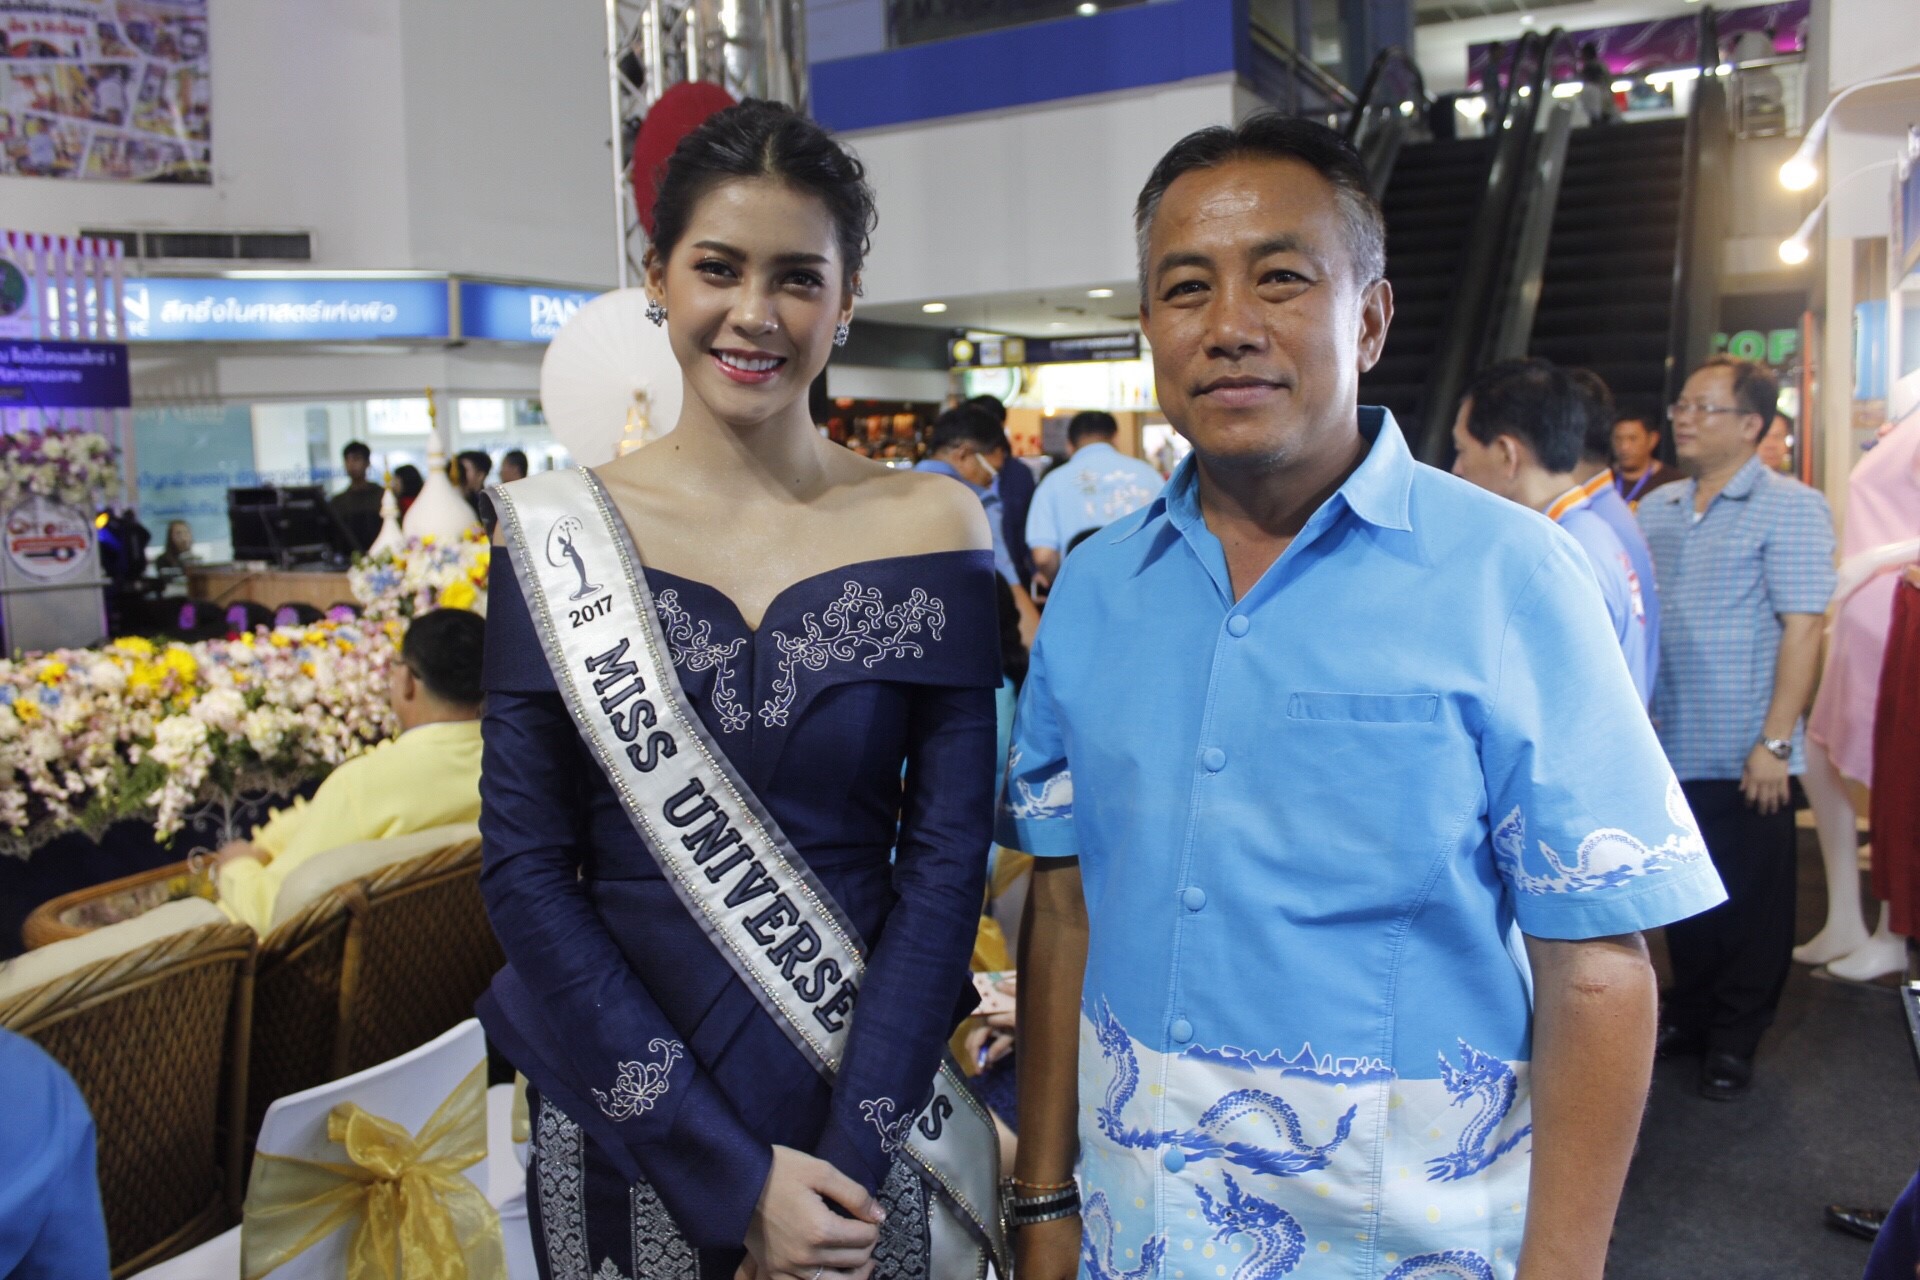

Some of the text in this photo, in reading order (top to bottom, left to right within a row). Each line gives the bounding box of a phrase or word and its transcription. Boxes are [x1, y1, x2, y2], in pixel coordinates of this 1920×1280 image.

[568, 595, 613, 629] 2017
[584, 637, 678, 772] MISS
[663, 777, 859, 1034] UNIVERSE
